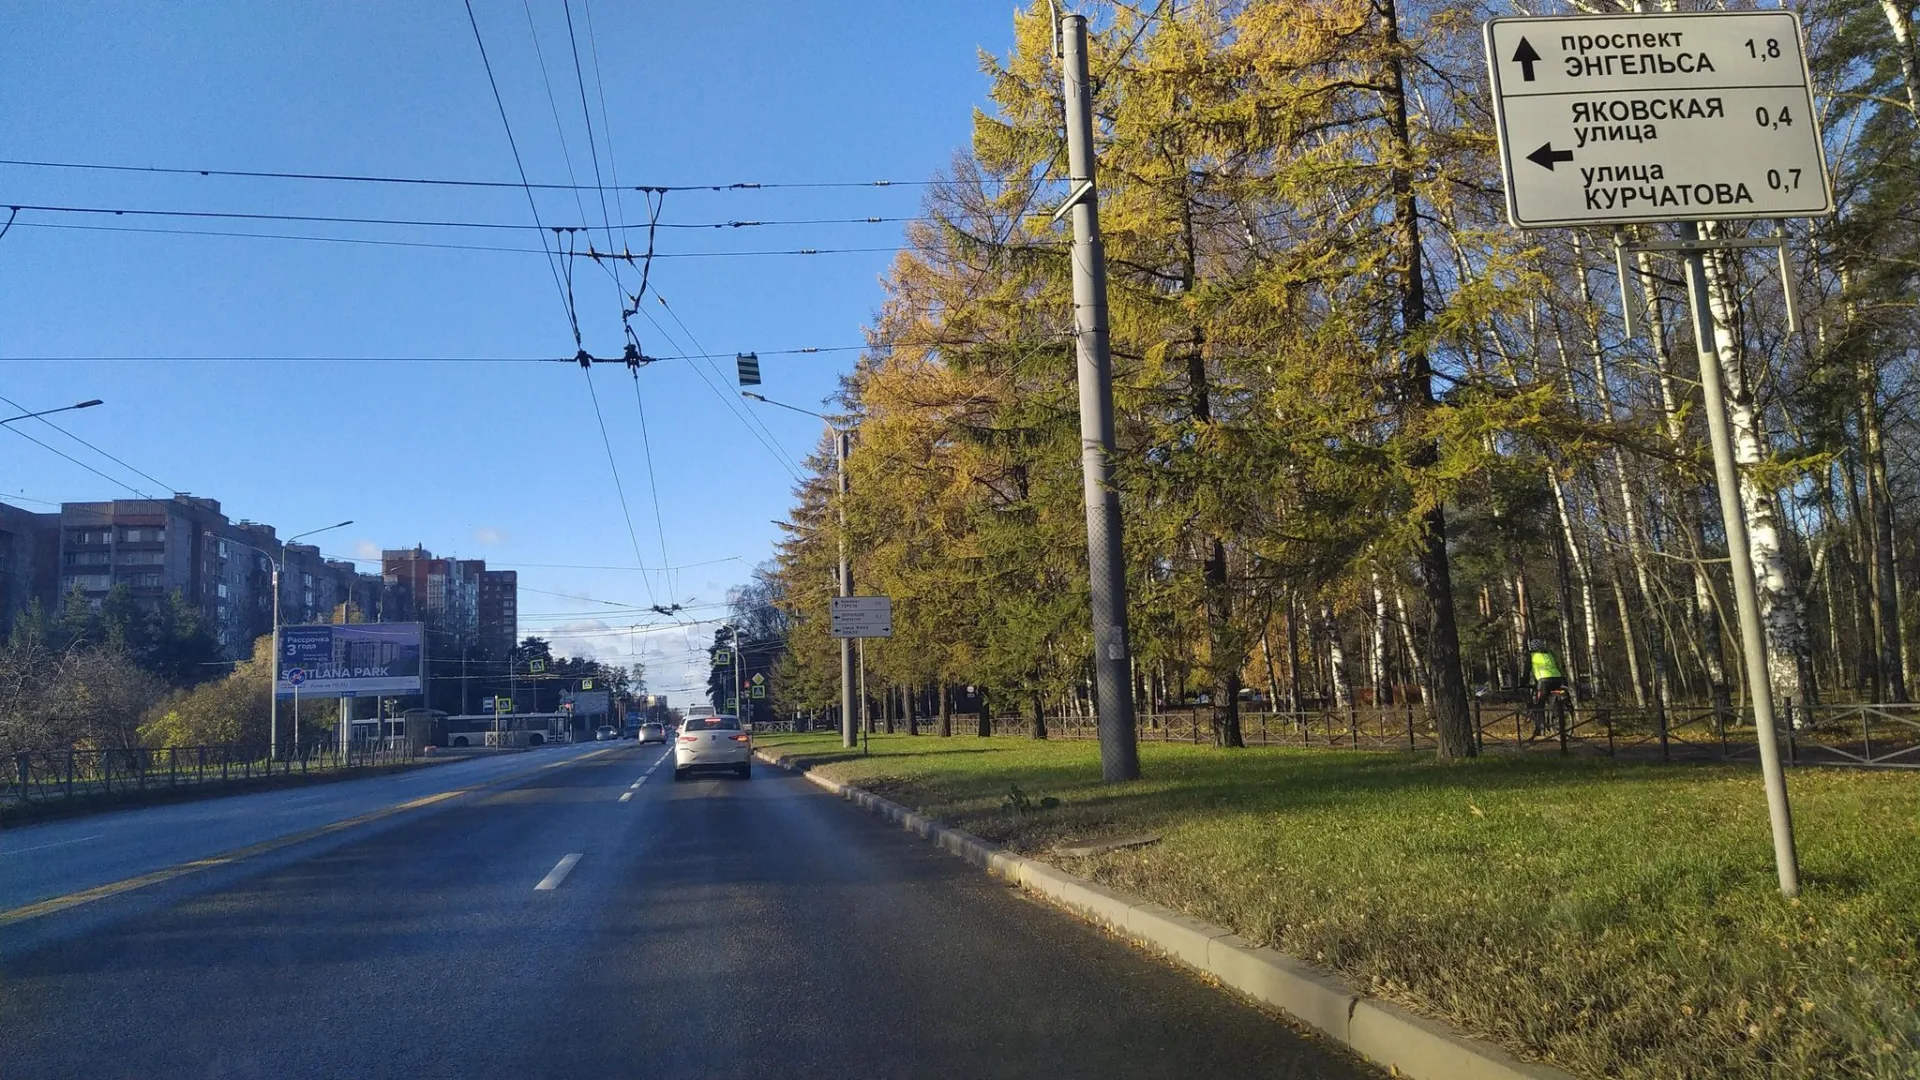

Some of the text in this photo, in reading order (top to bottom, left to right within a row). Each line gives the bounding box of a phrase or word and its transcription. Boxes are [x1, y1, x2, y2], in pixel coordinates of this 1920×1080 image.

[1561, 32, 1684, 55] проспект
[1745, 38, 1781, 62] 1,8
[1564, 52, 1716, 78] ЭНГЕЛЬСА
[1571, 97, 1725, 123] ЯКОВСКАЯ
[1755, 106, 1793, 130] 0,4
[1573, 123, 1658, 148] улица
[1580, 163, 1665, 188] улица
[1767, 168, 1802, 193] 0,7
[1583, 182, 1754, 210] КУРЧАТОВА
[286, 644, 297, 656] 3
[353, 666, 389, 677] PARK
